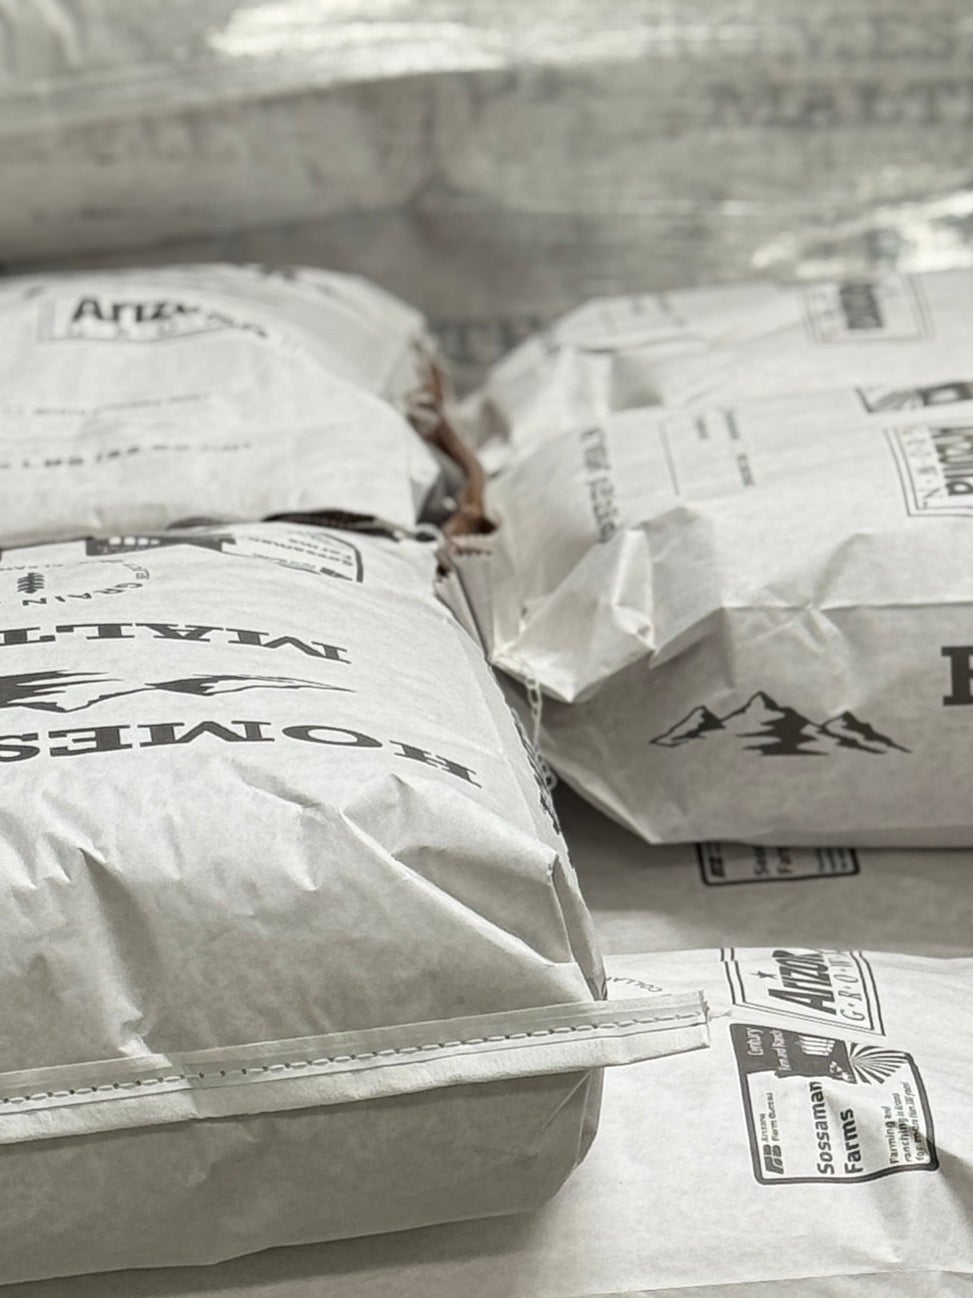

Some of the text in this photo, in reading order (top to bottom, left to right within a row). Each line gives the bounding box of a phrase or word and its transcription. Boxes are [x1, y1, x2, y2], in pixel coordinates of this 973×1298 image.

[809, 1081, 835, 1176] Sossaman
[839, 1108, 864, 1176] Farms
[885, 1121, 900, 1165] Farming
[896, 1117, 912, 1163] ranching
